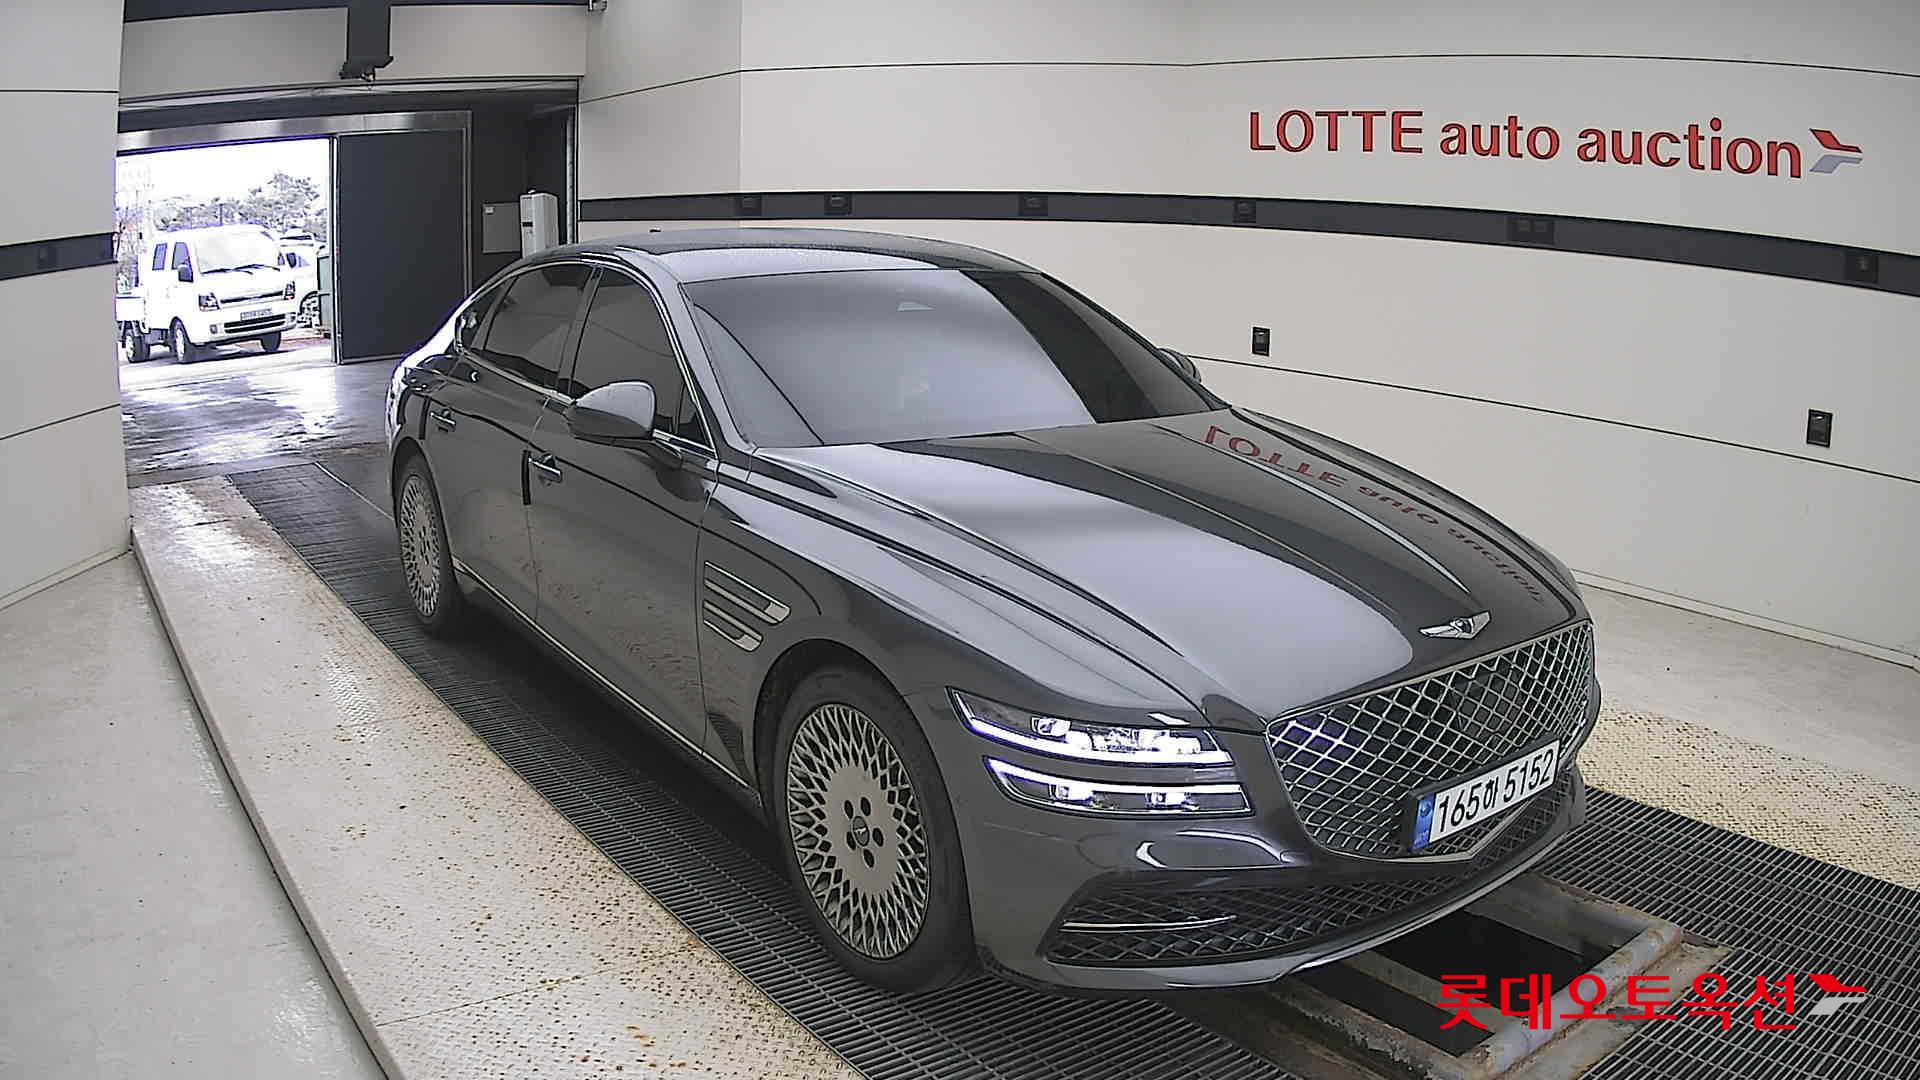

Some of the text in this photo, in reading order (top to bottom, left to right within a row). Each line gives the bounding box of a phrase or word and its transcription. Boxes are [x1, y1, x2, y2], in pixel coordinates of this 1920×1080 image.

[1249, 110, 1802, 179] LOTTE auto auction
[1438, 748, 1554, 833] 165하 5152
